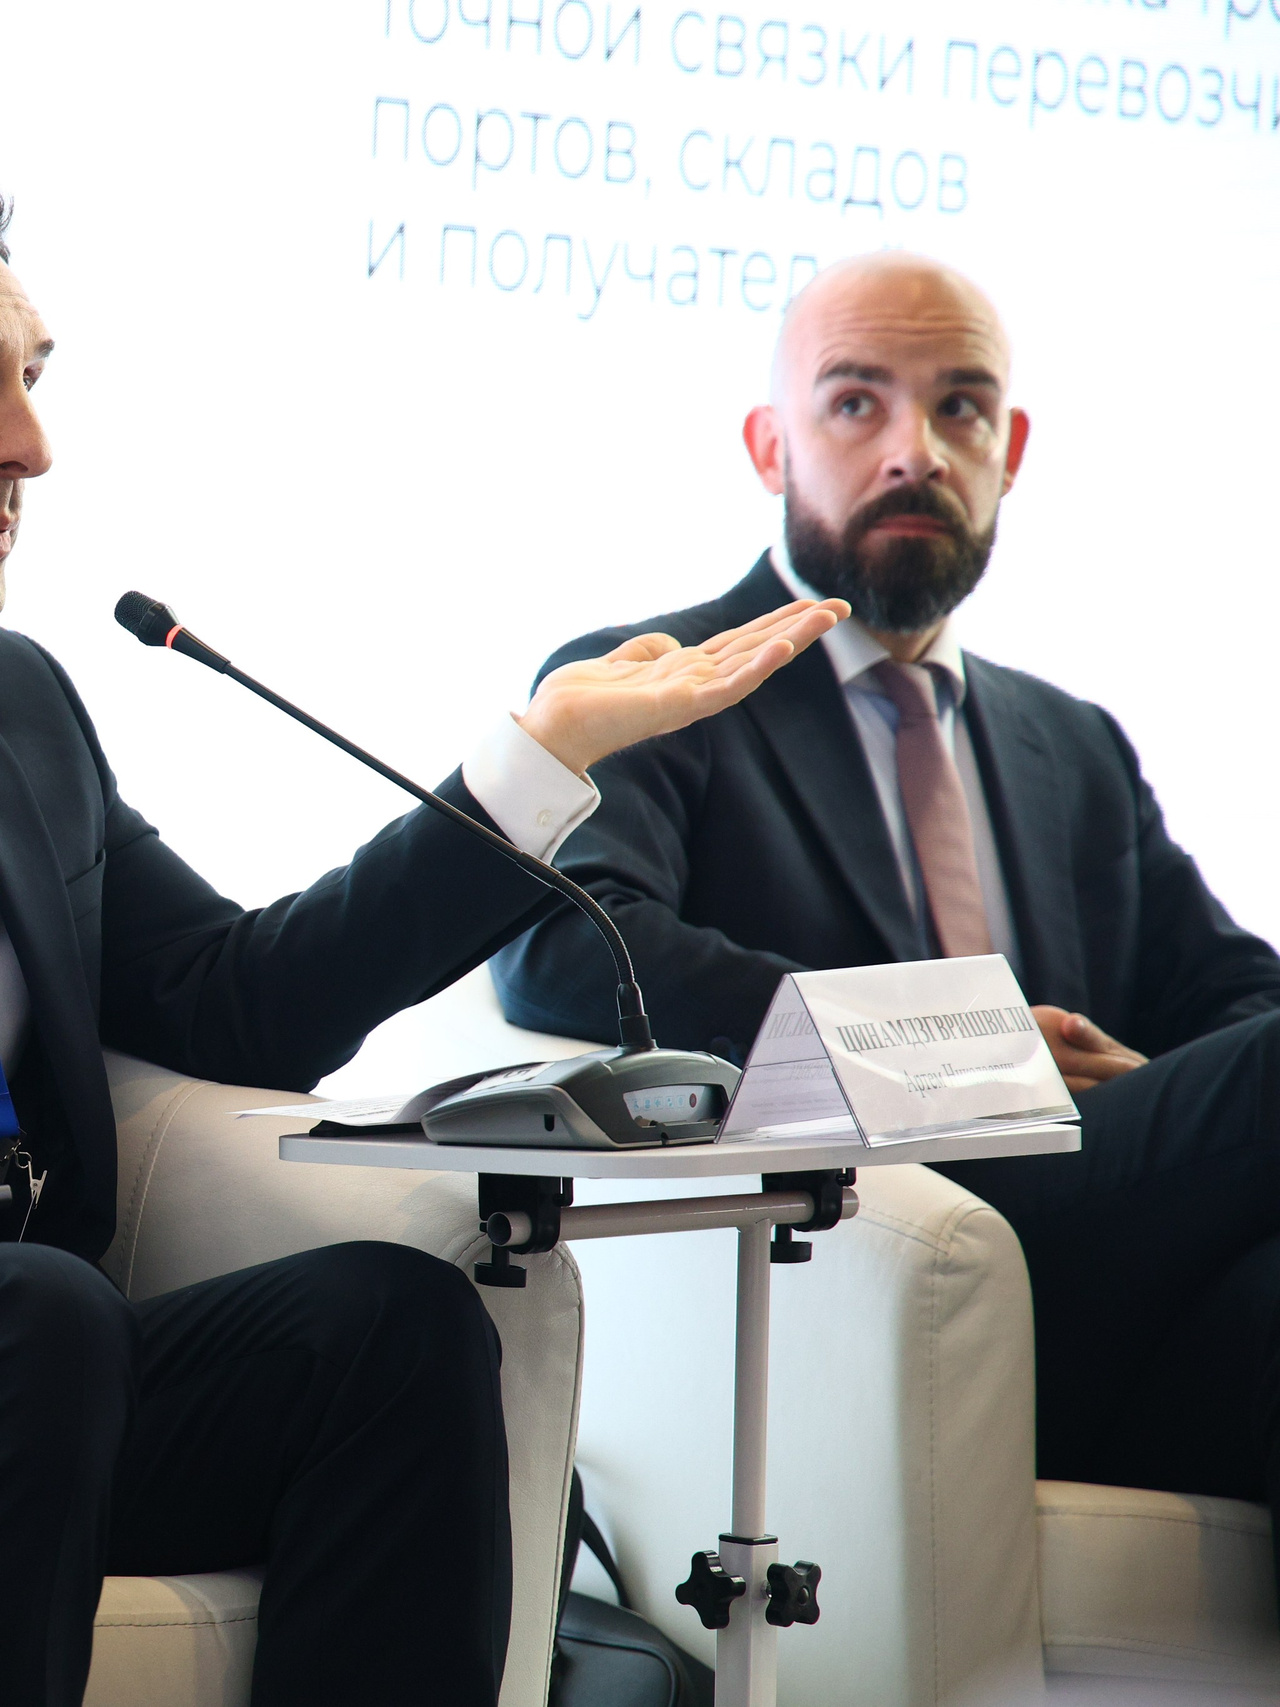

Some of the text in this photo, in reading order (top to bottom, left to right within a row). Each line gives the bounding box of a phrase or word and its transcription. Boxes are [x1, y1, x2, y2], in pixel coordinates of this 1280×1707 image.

[671, 9, 915, 93] связки
[943, 37, 1280, 130] перевозч
[372, 96, 970, 219] портов, складов
[368, 219, 820, 321] и получател
[903, 1069, 948, 1098] Артем
